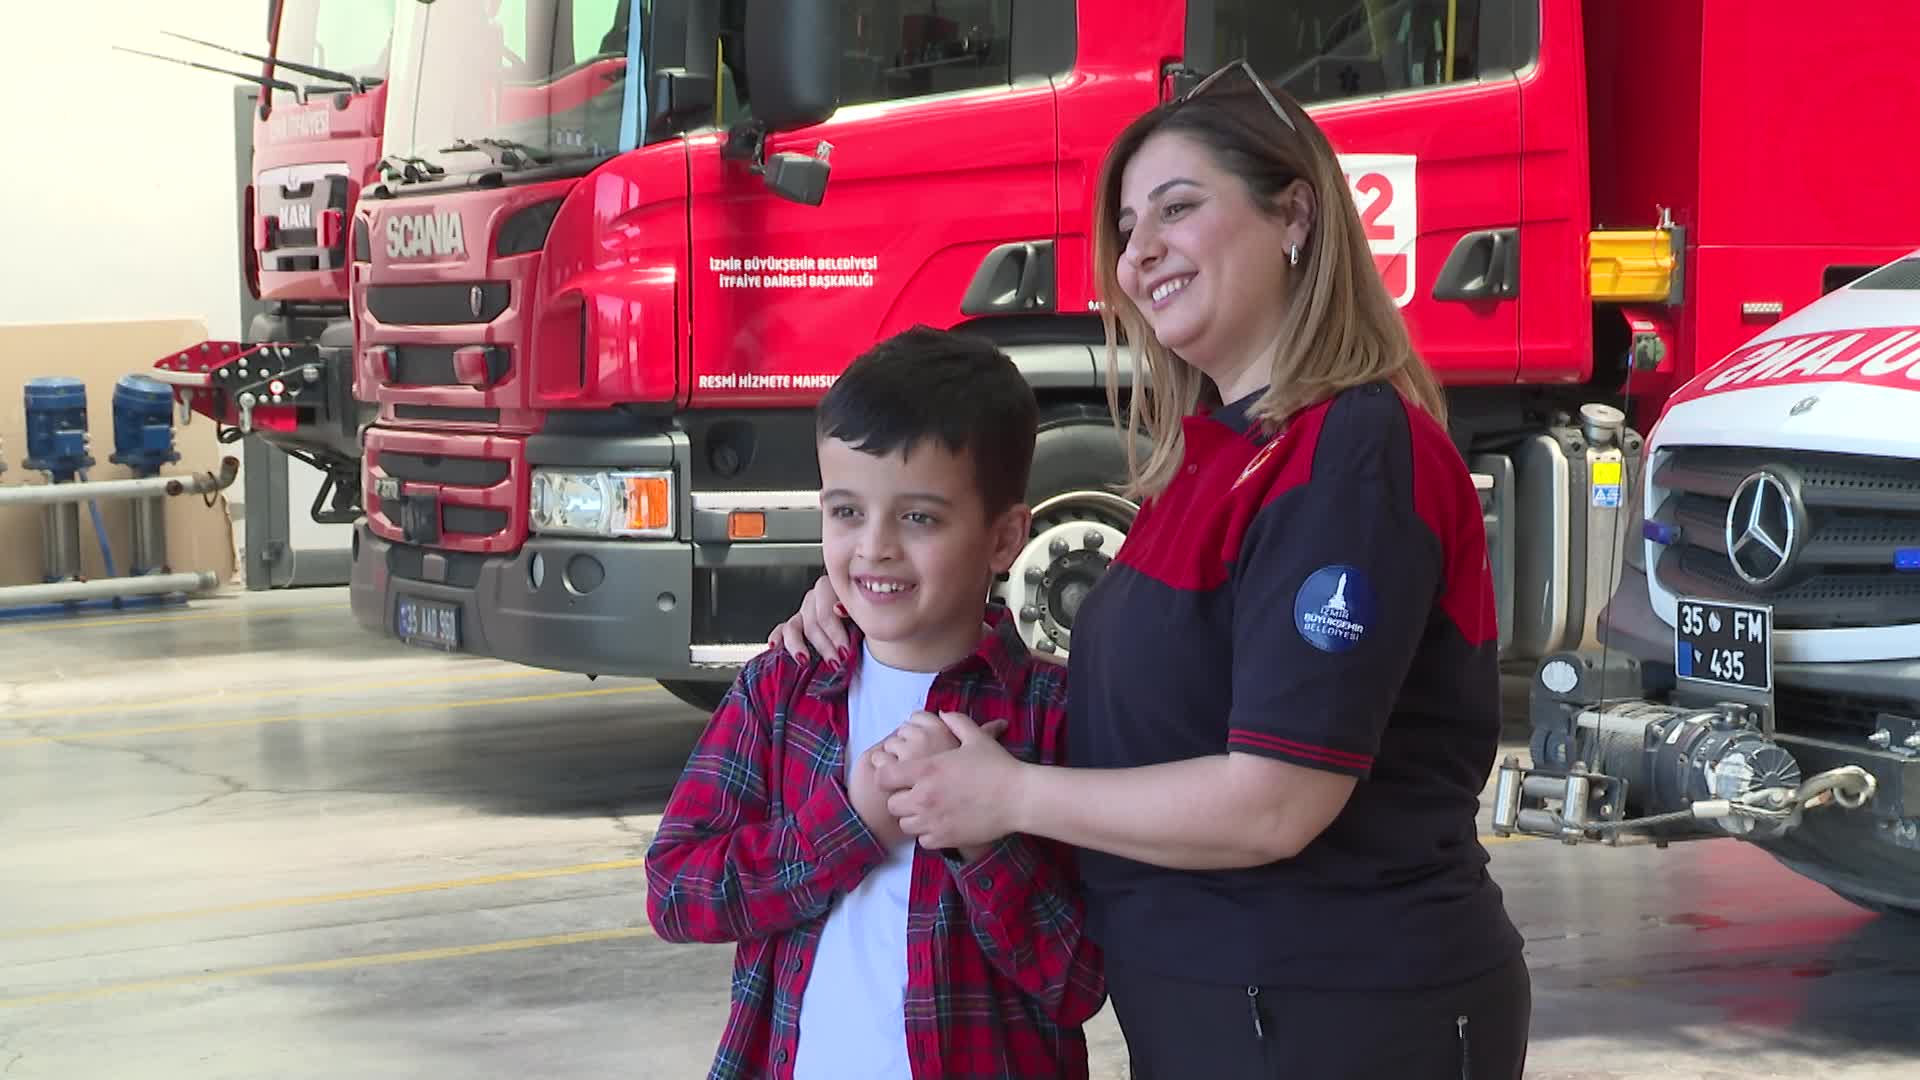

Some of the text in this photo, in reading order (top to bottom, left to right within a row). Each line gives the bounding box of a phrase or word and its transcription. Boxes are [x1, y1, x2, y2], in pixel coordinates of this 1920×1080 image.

[279, 204, 311, 228] MAN
[1344, 173, 1395, 240] 2
[387, 211, 465, 257] SCANIA
[709, 255, 878, 273] İZMİR BÜYÜKŞEHİR BELEDİYESİ
[719, 272, 873, 289] İTFAİYE DAİRESİ BAŞKANLIĞI
[699, 373, 736, 388] RESMİ
[739, 373, 790, 388] HİZMETE
[1682, 605, 1762, 643] 35 FM
[1710, 649, 1744, 681] 435
